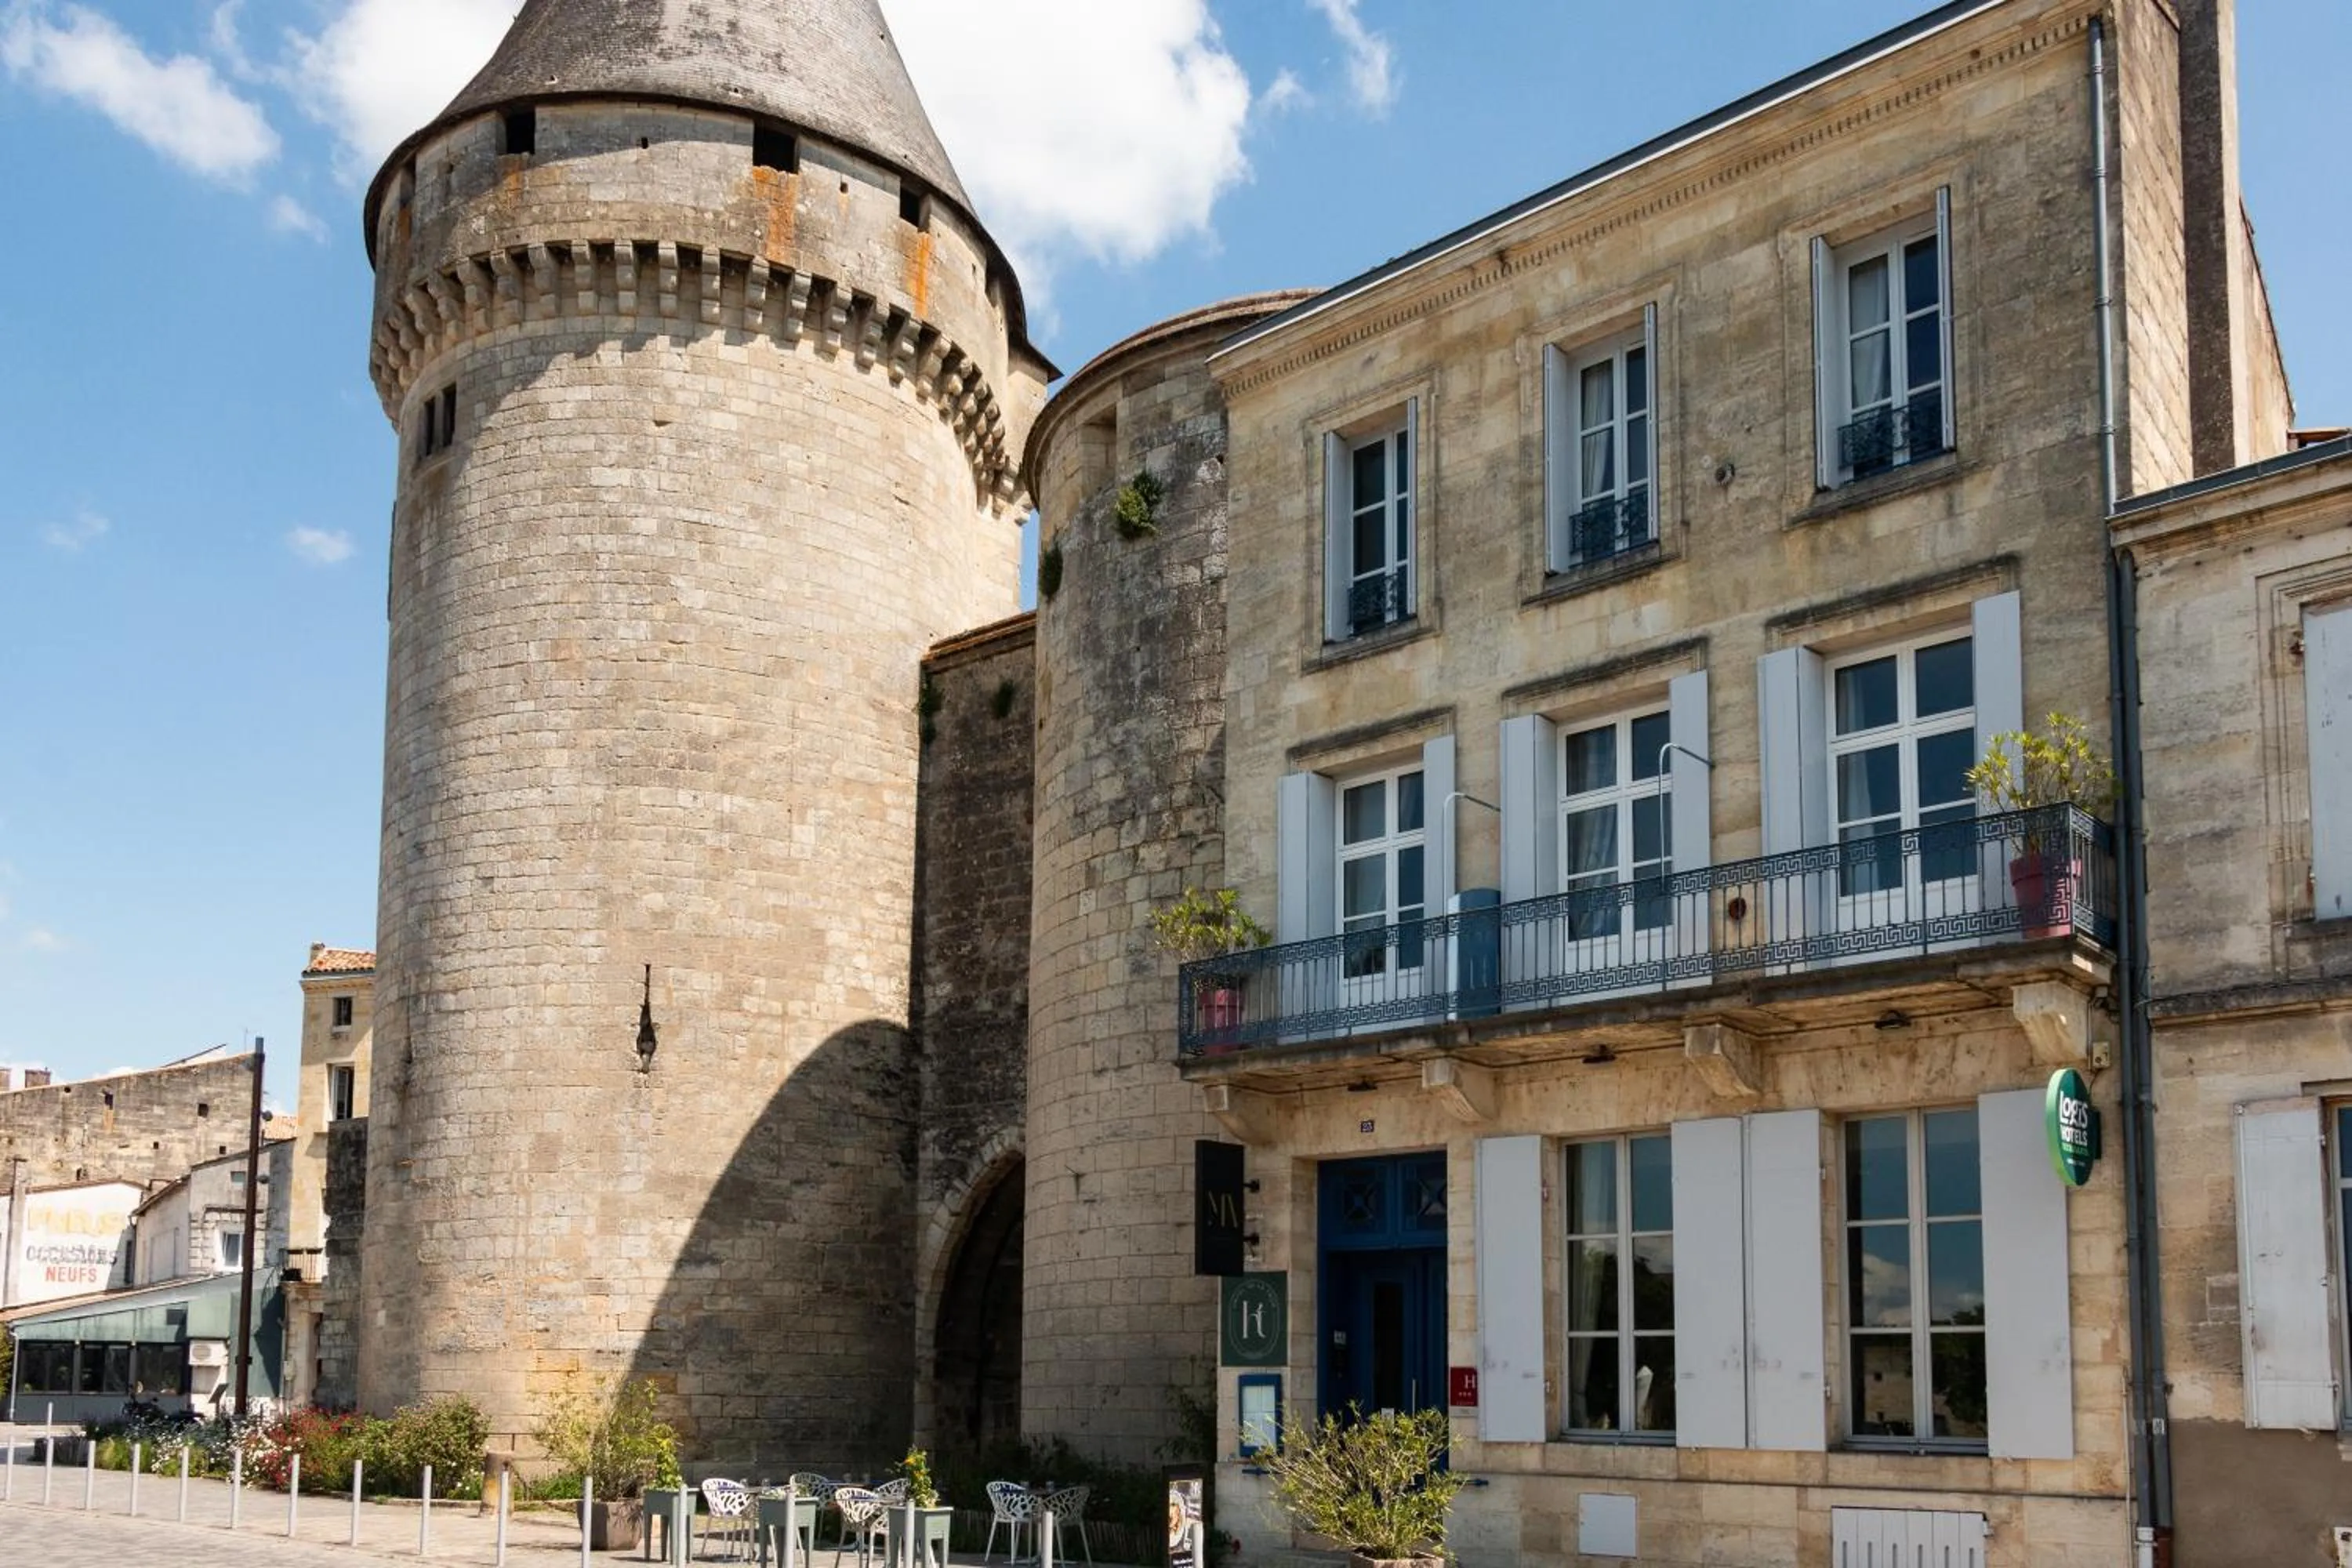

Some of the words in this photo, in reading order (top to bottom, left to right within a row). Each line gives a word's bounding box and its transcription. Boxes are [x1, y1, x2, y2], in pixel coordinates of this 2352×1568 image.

[2060, 1124, 2088, 1145] HOTELS
[45, 1266, 98, 1283] NEUFS
[1465, 1374, 1476, 1389] H
